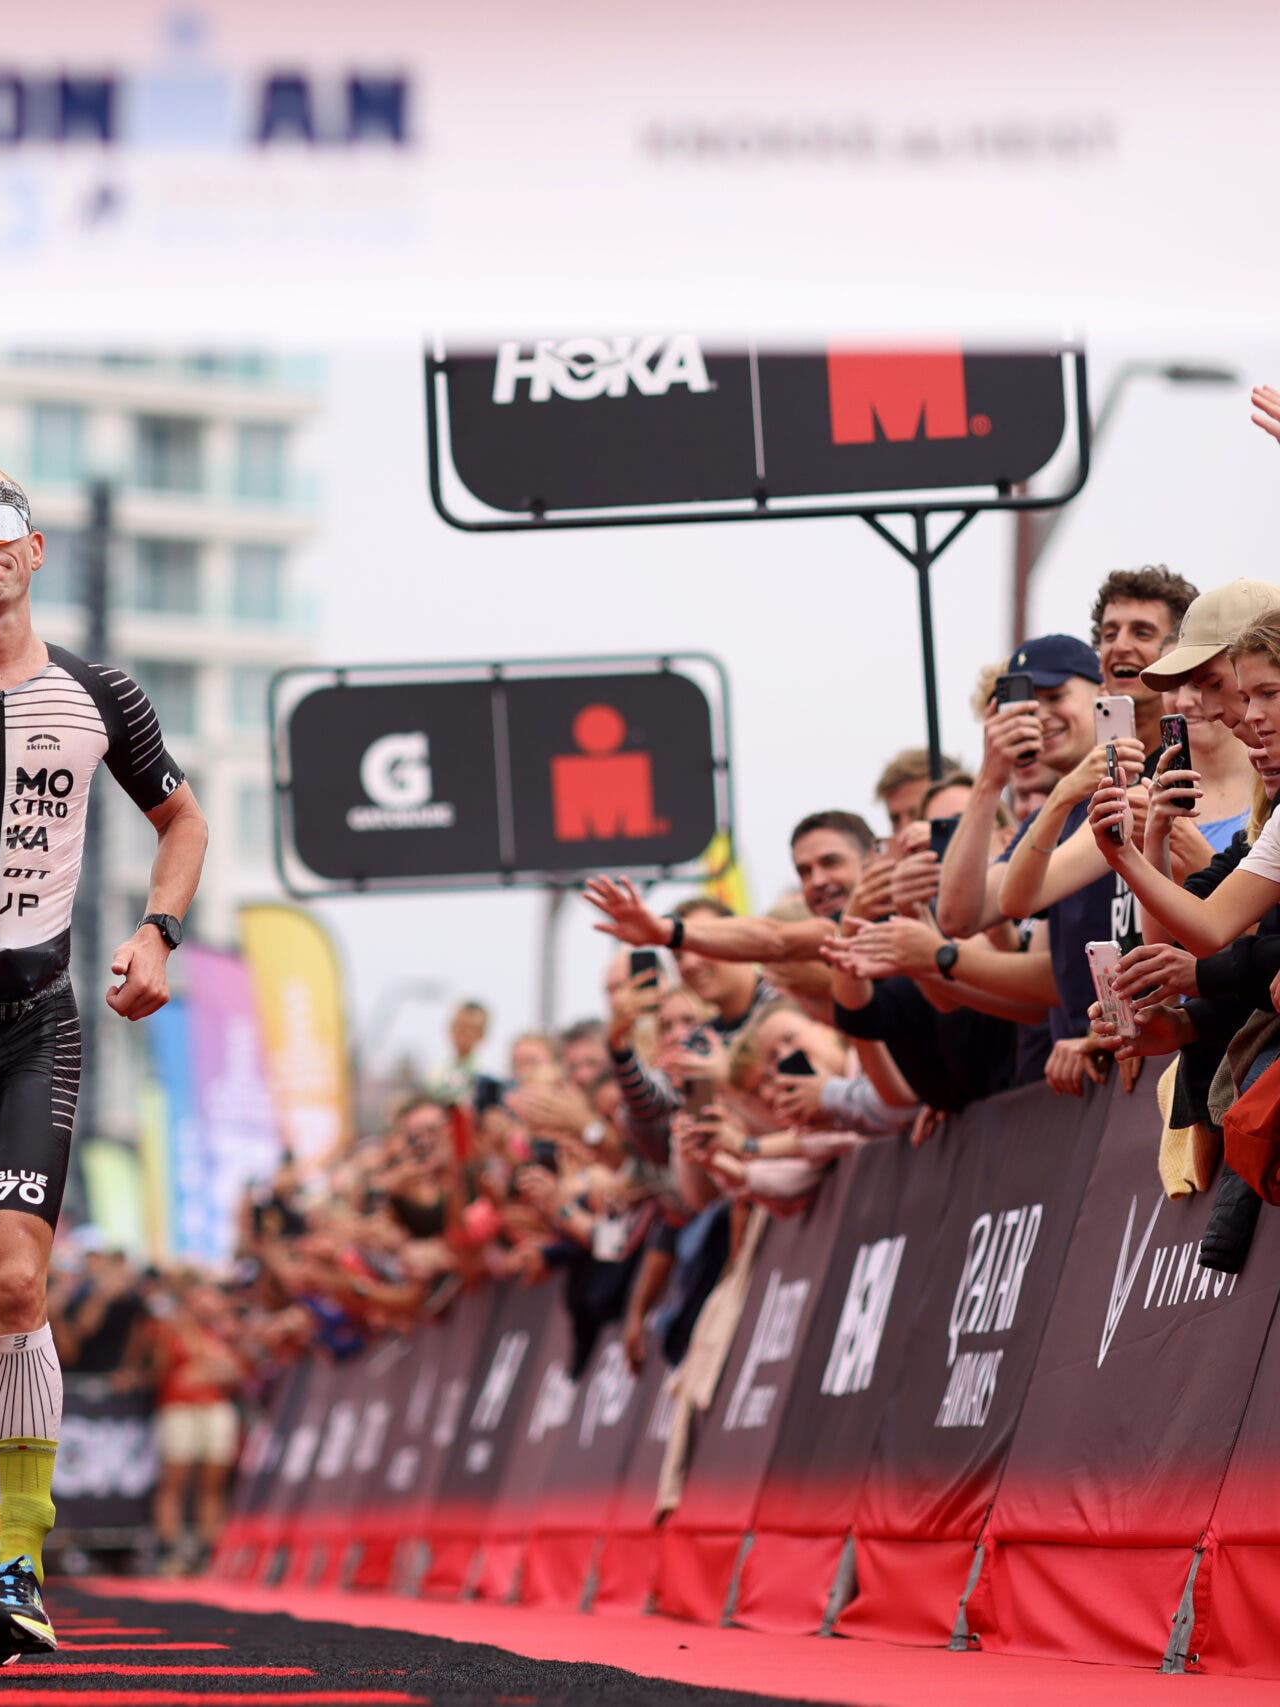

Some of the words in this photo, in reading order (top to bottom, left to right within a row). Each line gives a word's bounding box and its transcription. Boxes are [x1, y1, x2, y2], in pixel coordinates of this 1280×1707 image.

[492, 335, 711, 404] HOKA
[26, 743, 61, 751] skinfit
[947, 1203, 1043, 1367] QATAR
